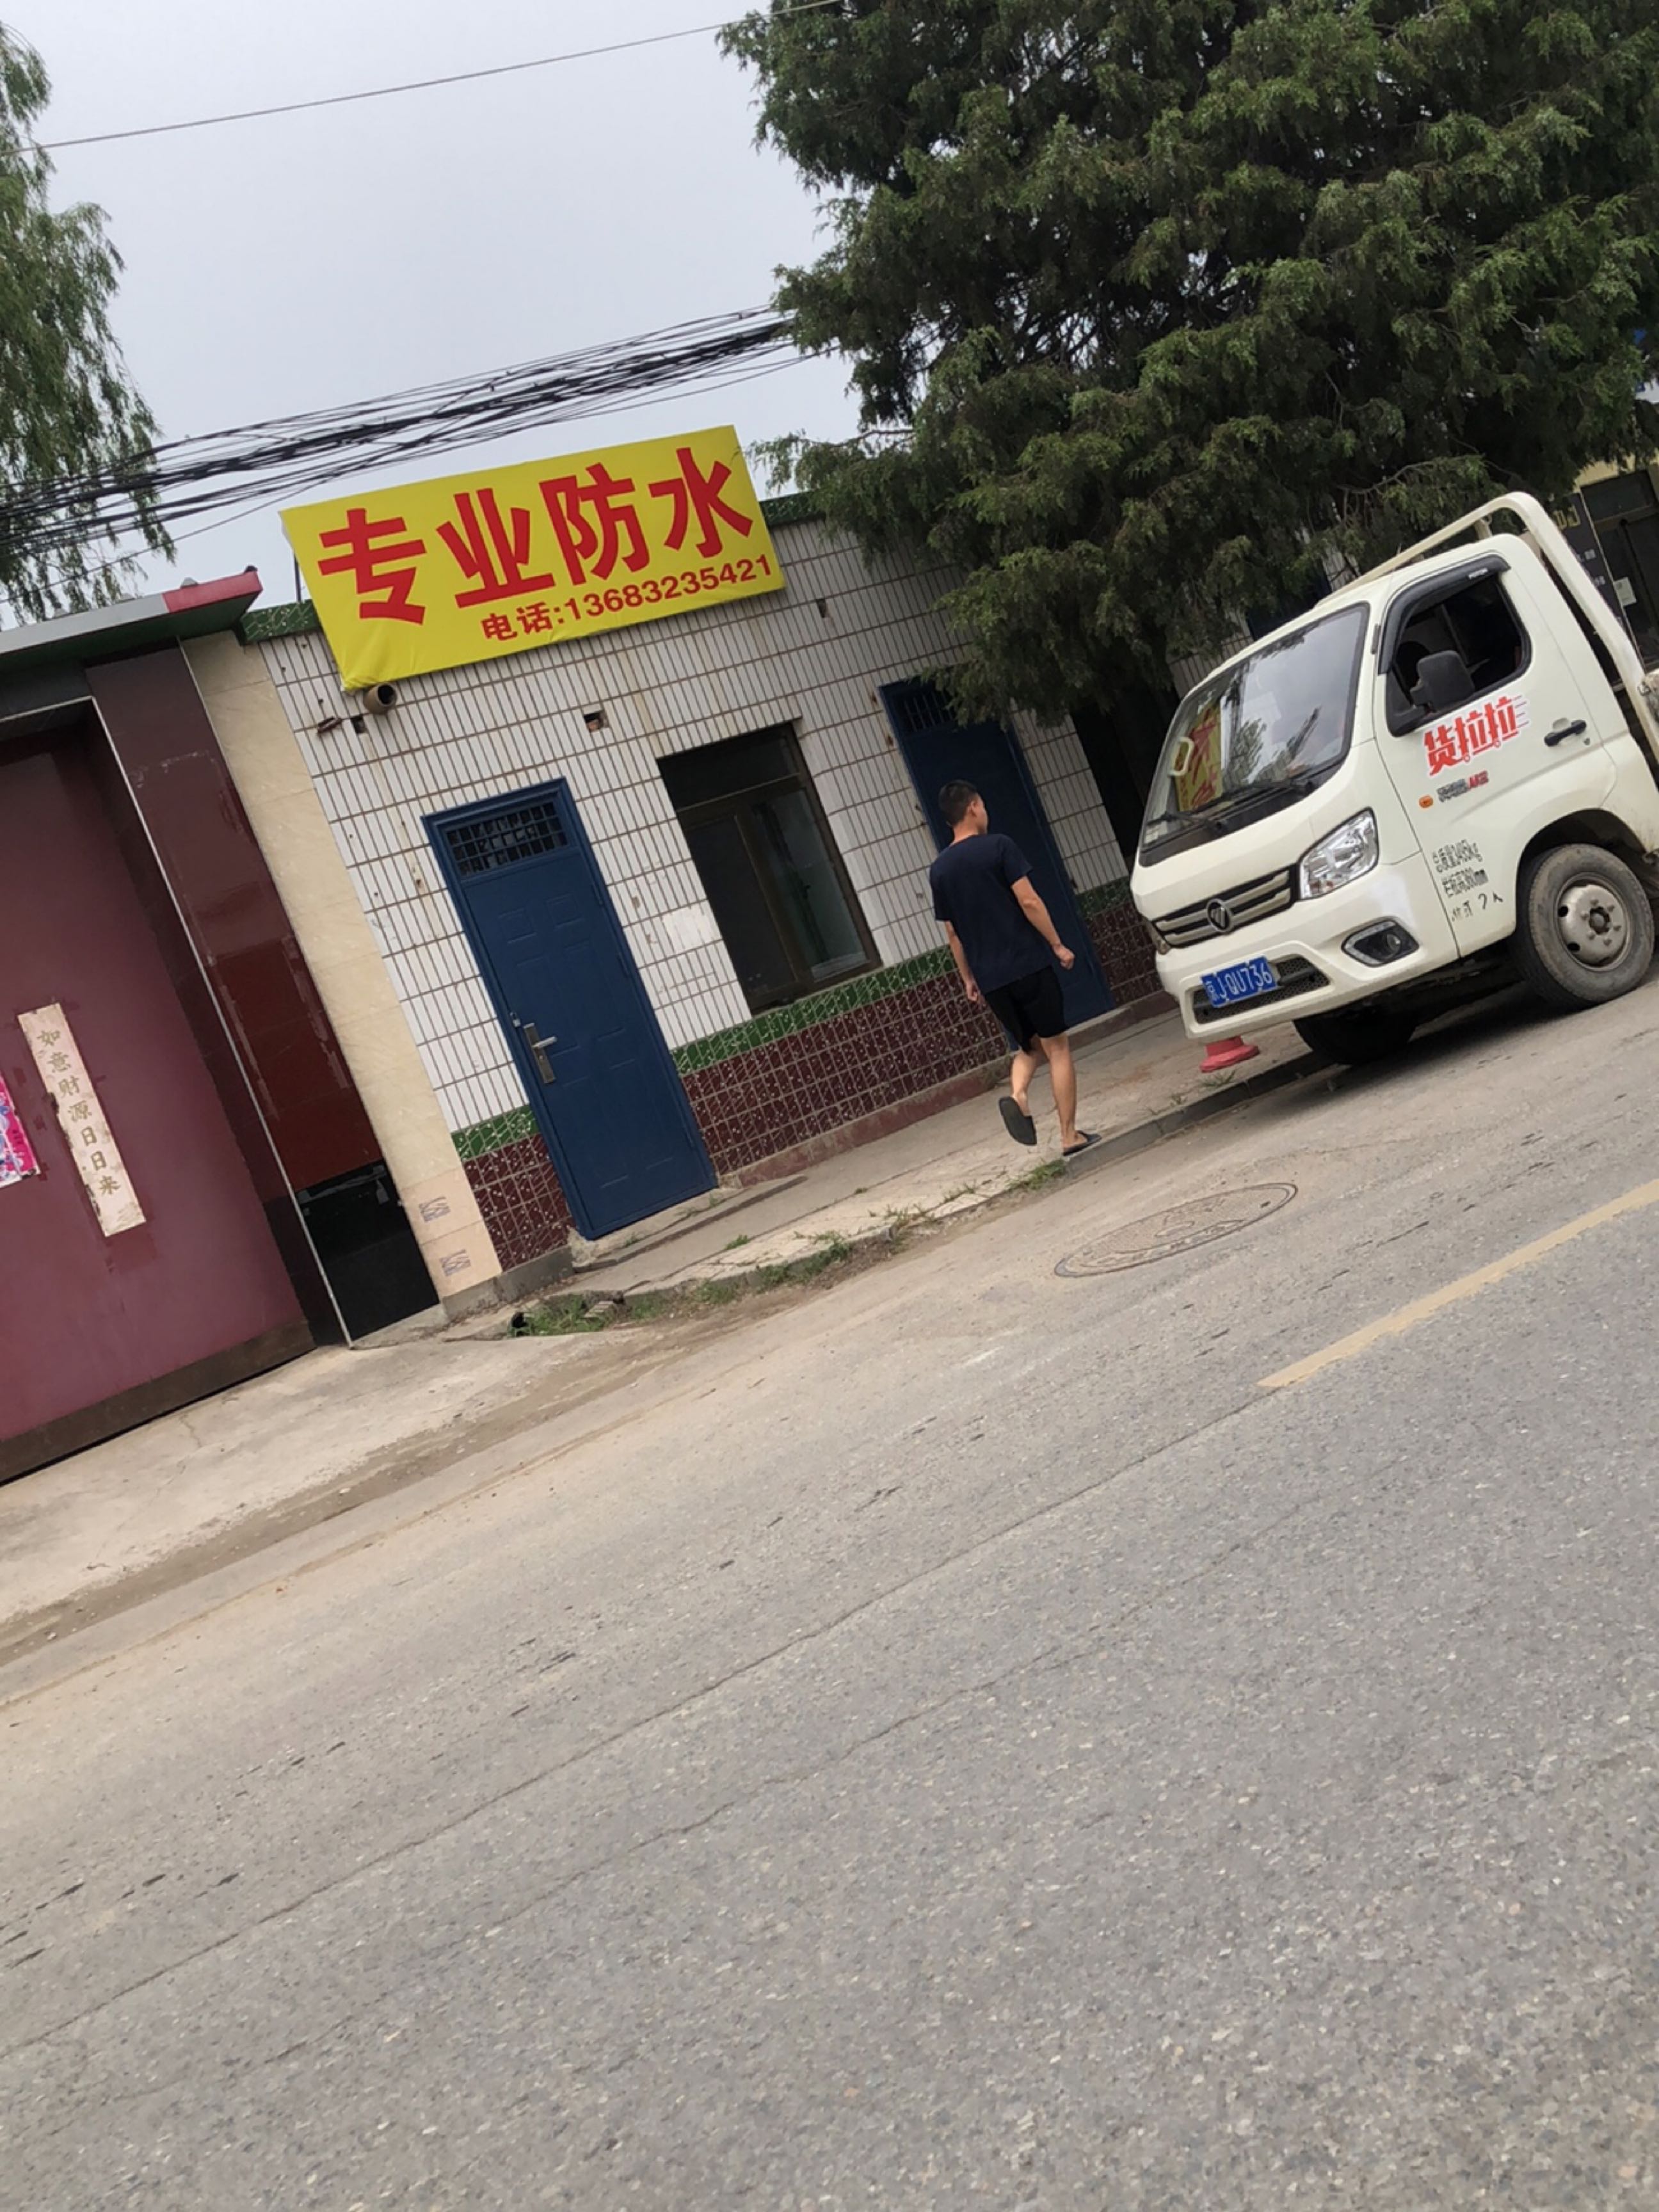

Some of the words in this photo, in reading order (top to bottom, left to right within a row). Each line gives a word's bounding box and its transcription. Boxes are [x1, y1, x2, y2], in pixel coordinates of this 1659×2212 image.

[317, 447, 753, 625] 专业防水
[1423, 695, 1519, 776] 货拉拉
